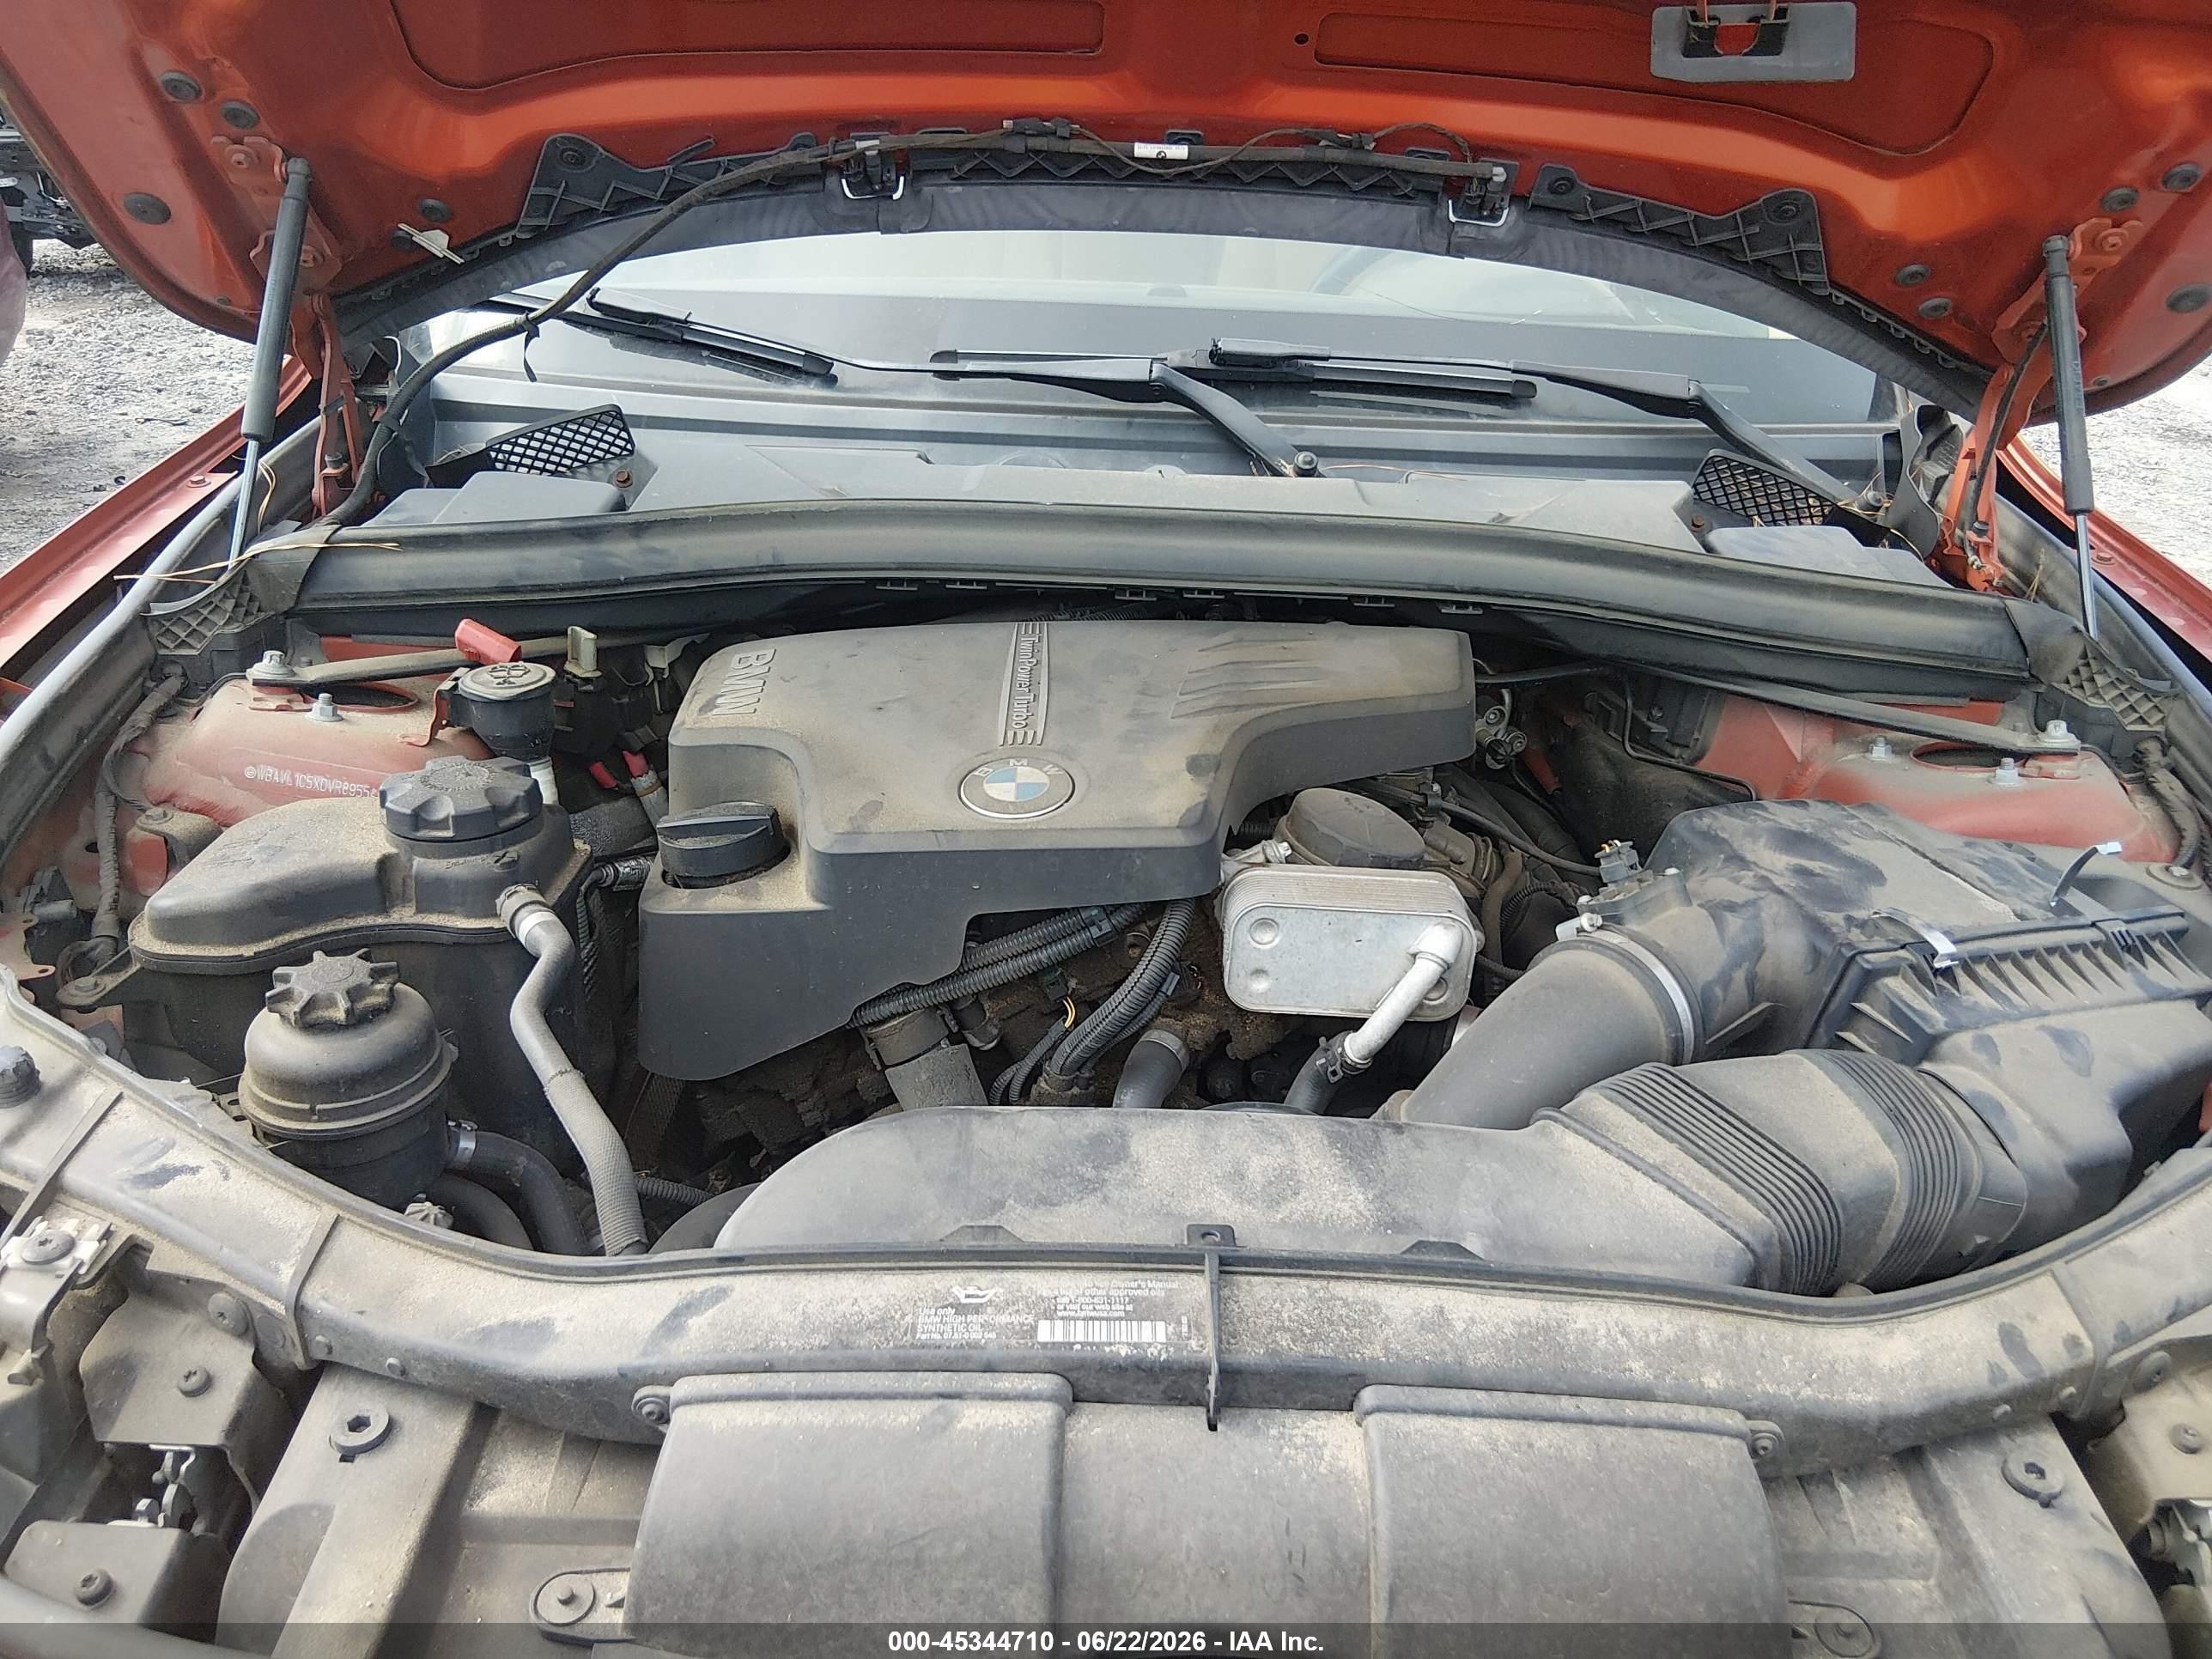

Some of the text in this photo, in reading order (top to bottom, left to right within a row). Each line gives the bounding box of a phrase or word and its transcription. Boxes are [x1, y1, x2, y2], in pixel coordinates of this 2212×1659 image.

[712, 647, 776, 715] BMW
[974, 758, 1063, 777] BMW
[937, 1306, 956, 1316] only
[919, 1315, 942, 1323] BMW
[945, 1315, 965, 1323] HIGH
[917, 1323, 967, 1333] SYNTHETIC
